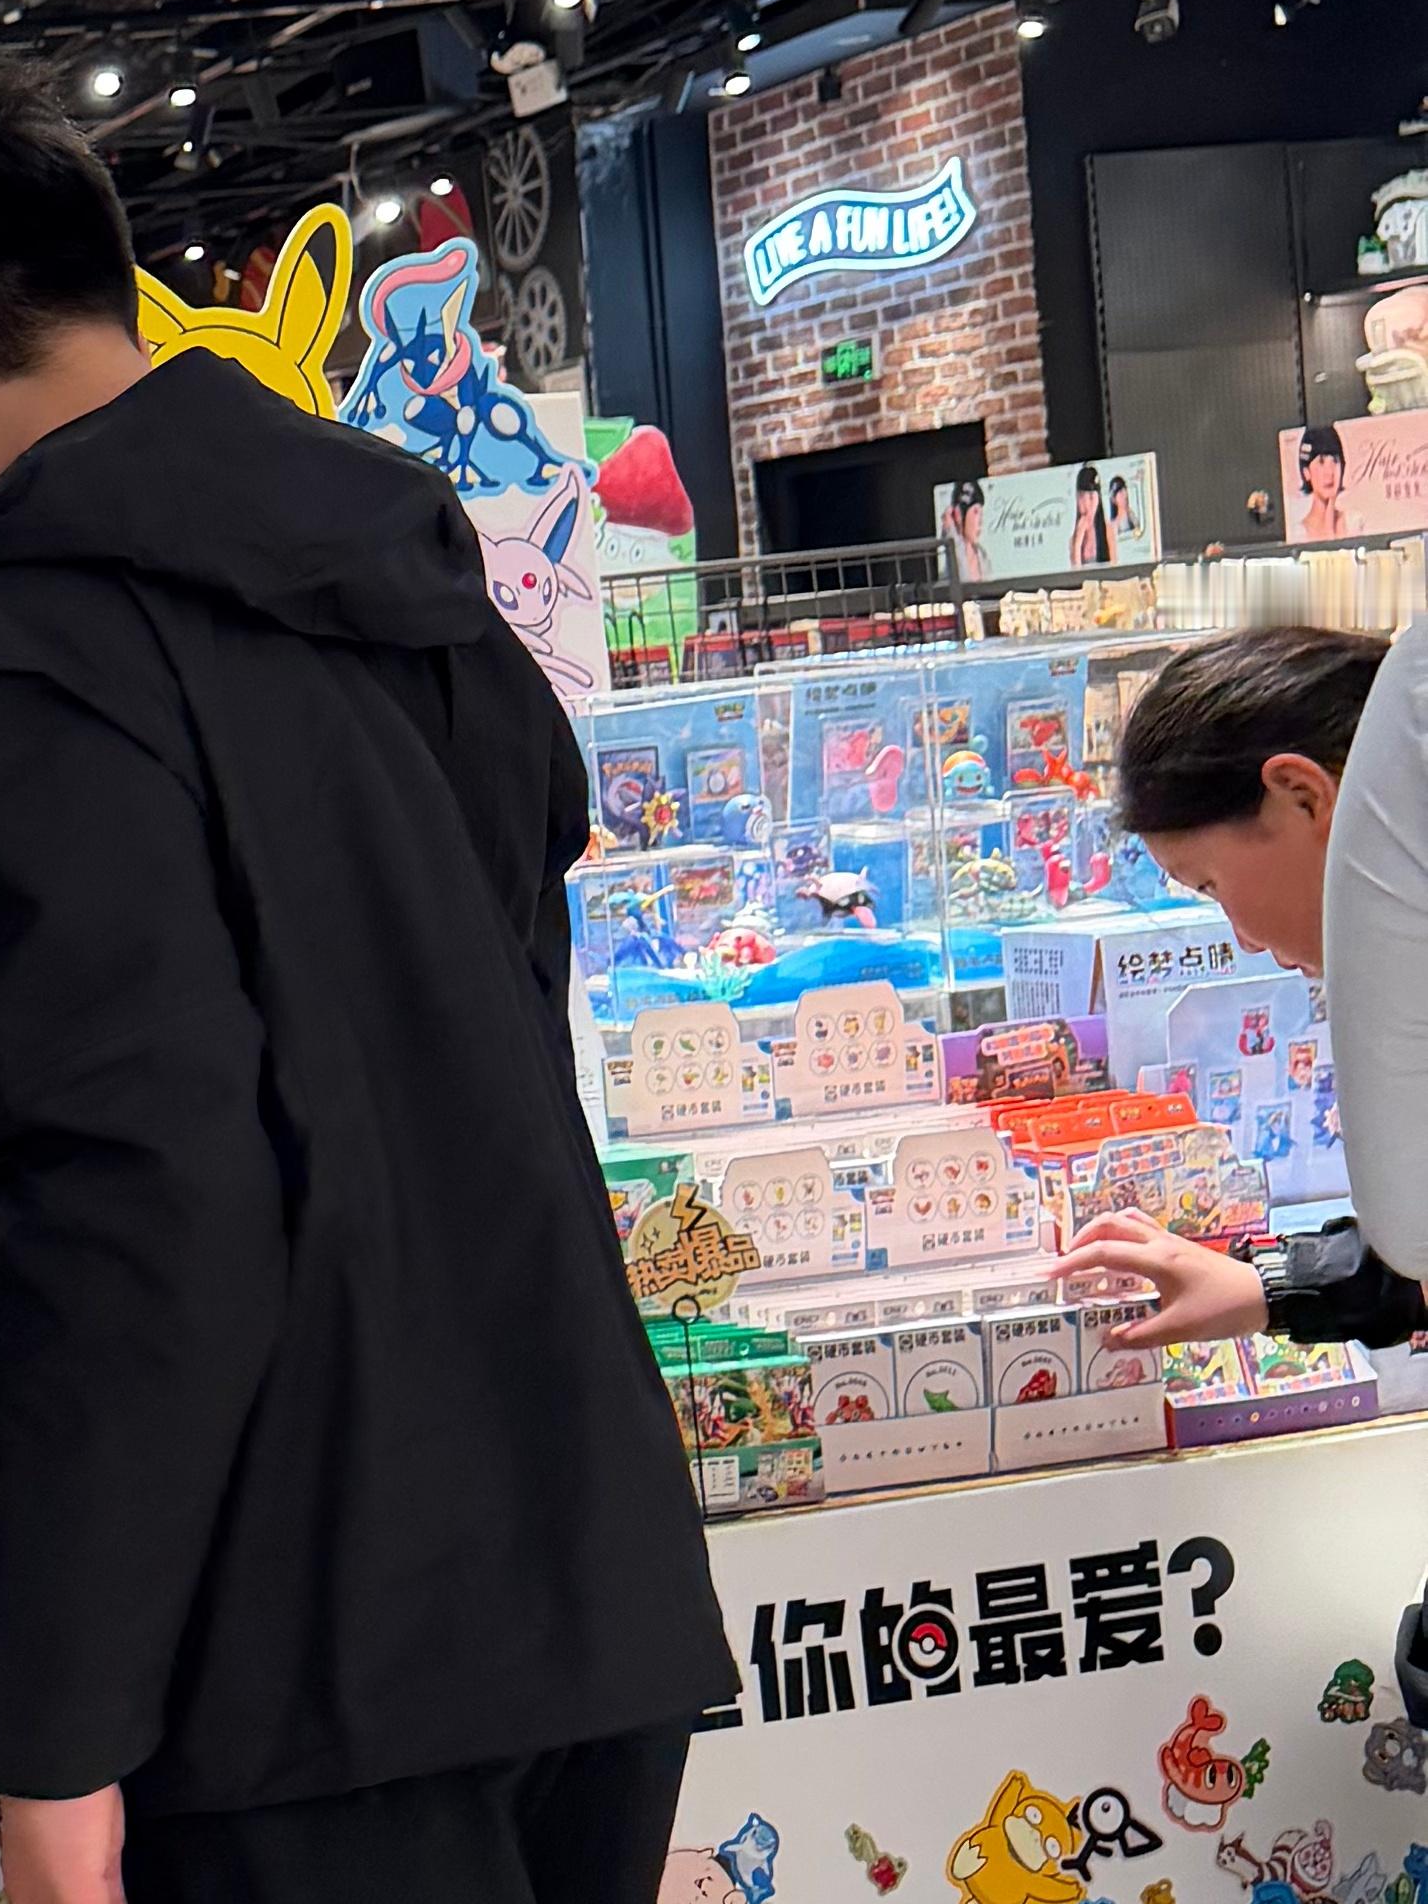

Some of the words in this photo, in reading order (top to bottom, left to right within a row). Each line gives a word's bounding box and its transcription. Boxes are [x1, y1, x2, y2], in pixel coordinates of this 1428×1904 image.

[755, 220, 807, 288] LIVE
[808, 210, 833, 256] A
[836, 205, 889, 253] FUN
[694, 1535, 1236, 1731] 你的最爱?
